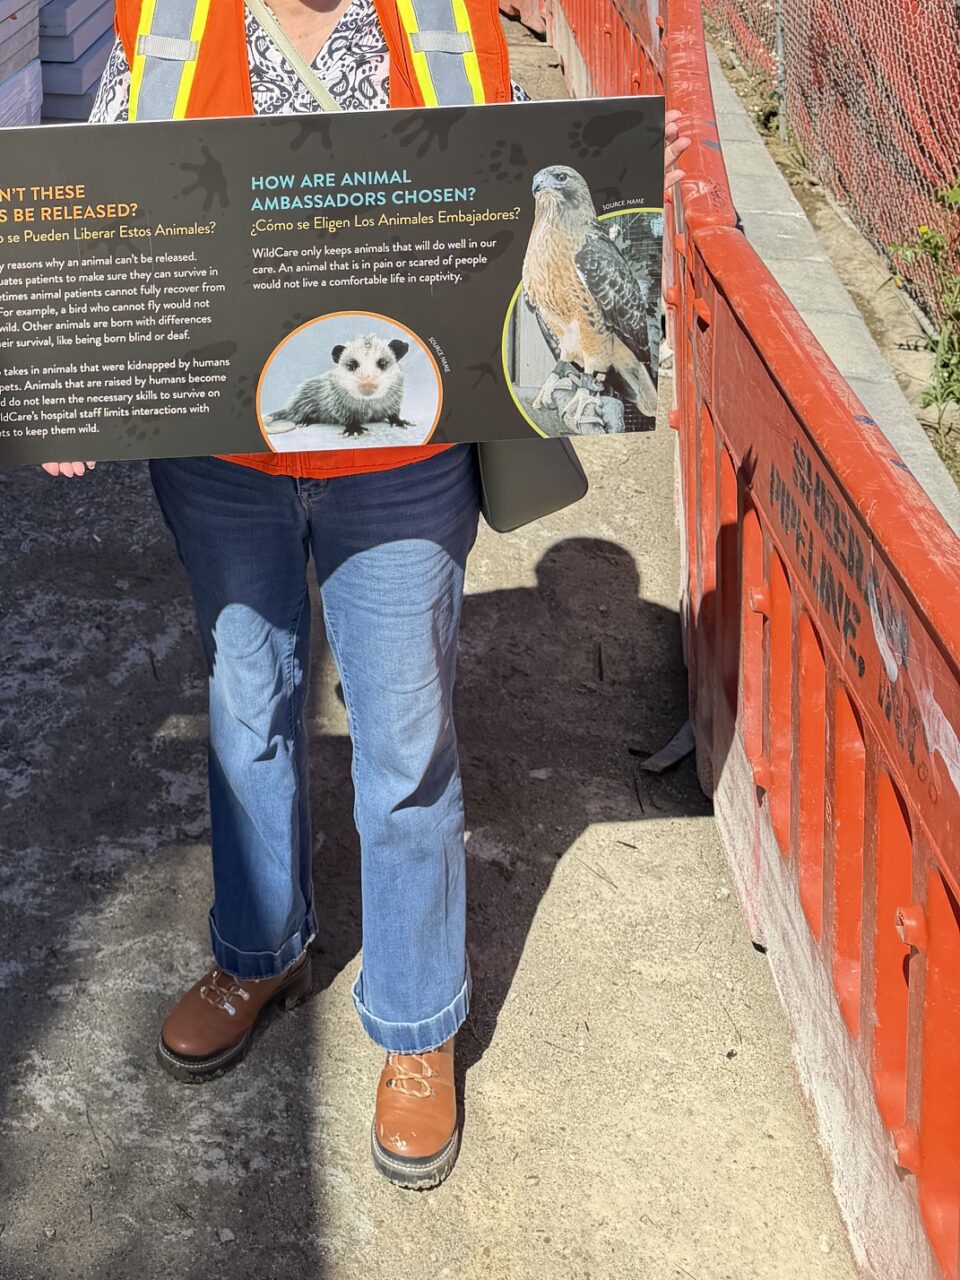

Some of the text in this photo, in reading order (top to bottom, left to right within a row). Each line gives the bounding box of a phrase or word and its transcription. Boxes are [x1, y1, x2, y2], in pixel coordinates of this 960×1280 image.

[251, 169, 411, 190] HOW ARE ANIMAL
[30, 184, 85, 200] THESE
[251, 187, 475, 211] AMBASSADORS CHOSEN?
[13, 207, 34, 221] BE
[40, 202, 137, 220] RELEASED?
[250, 206, 520, 236] ¿Cómo se Eligen Los Animales Embajadores?
[7, 234, 20, 243] se
[23, 228, 69, 242] Pueden
[73, 227, 115, 239] Liberar
[119, 225, 151, 237] Estos
[154, 221, 216, 236] Animales?
[252, 246, 298, 258] WildCare
[300, 245, 322, 259] only
[324, 244, 352, 257] keeps
[354, 242, 390, 253] animals
[392, 241, 412, 252] that
[414, 240, 430, 250] will
[432, 239, 445, 249] do
[447, 238, 466, 249] well
[468, 239, 477, 248] in
[7, 261, 43, 269] reasons
[44, 257, 65, 270] why
[81, 255, 112, 266] animal
[114, 253, 138, 264] can't
[140, 253, 153, 263] be
[155, 251, 197, 262] released.
[252, 266, 276, 274] care.
[278, 262, 293, 272] An
[295, 261, 326, 272] animal
[329, 260, 349, 270] that
[352, 260, 359, 269] is
[361, 260, 370, 268] in
[373, 259, 393, 272] pain
[408, 255, 439, 267] scared
[442, 254, 453, 265] of
[454, 253, 487, 268] people
[25, 273, 63, 288] patients
[65, 274, 76, 282] to
[78, 271, 104, 281] make
[129, 269, 151, 282] they
[173, 268, 207, 277] survive
[209, 267, 218, 275] in
[252, 278, 281, 289] would
[283, 280, 300, 288] not
[302, 277, 318, 287] live
[329, 274, 388, 286] comfortable
[390, 272, 405, 283] life
[407, 274, 416, 282] in
[418, 271, 462, 285] captivity.
[3, 365, 28, 376] takes
[30, 365, 40, 374] in
[42, 363, 77, 374] animals
[79, 362, 99, 372] that
[127, 358, 176, 372] kidnapped
[178, 358, 190, 371] by
[192, 357, 230, 367] humans
[25, 426, 48, 438] keep
[50, 425, 76, 434] them
[78, 423, 99, 433] wild.
